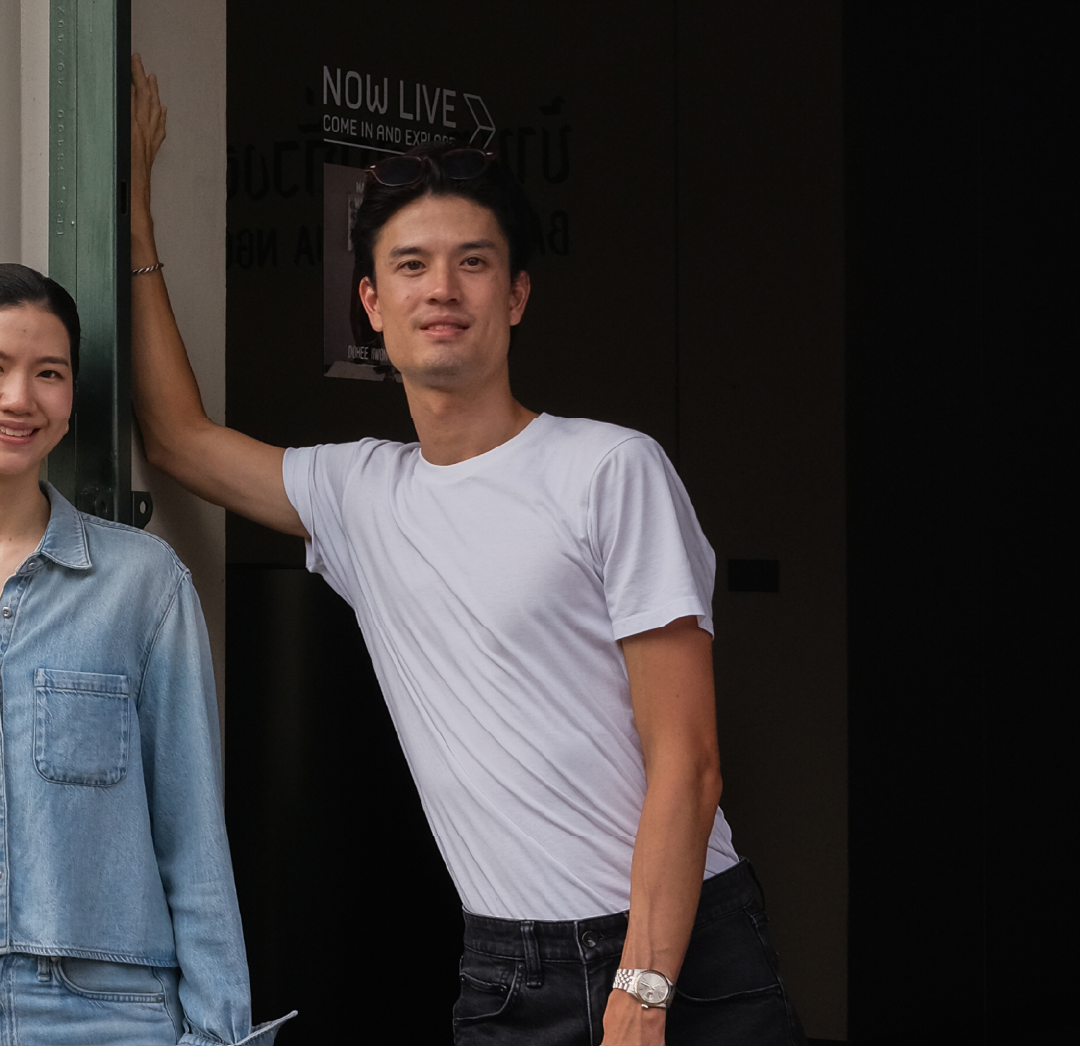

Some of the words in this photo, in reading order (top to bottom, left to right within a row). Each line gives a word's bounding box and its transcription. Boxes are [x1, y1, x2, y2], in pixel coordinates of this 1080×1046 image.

[323, 65, 388, 115] NOW
[400, 80, 457, 129] LIVE
[323, 114, 357, 136] COME
[361, 121, 373, 139] IN
[376, 124, 401, 144] AND
